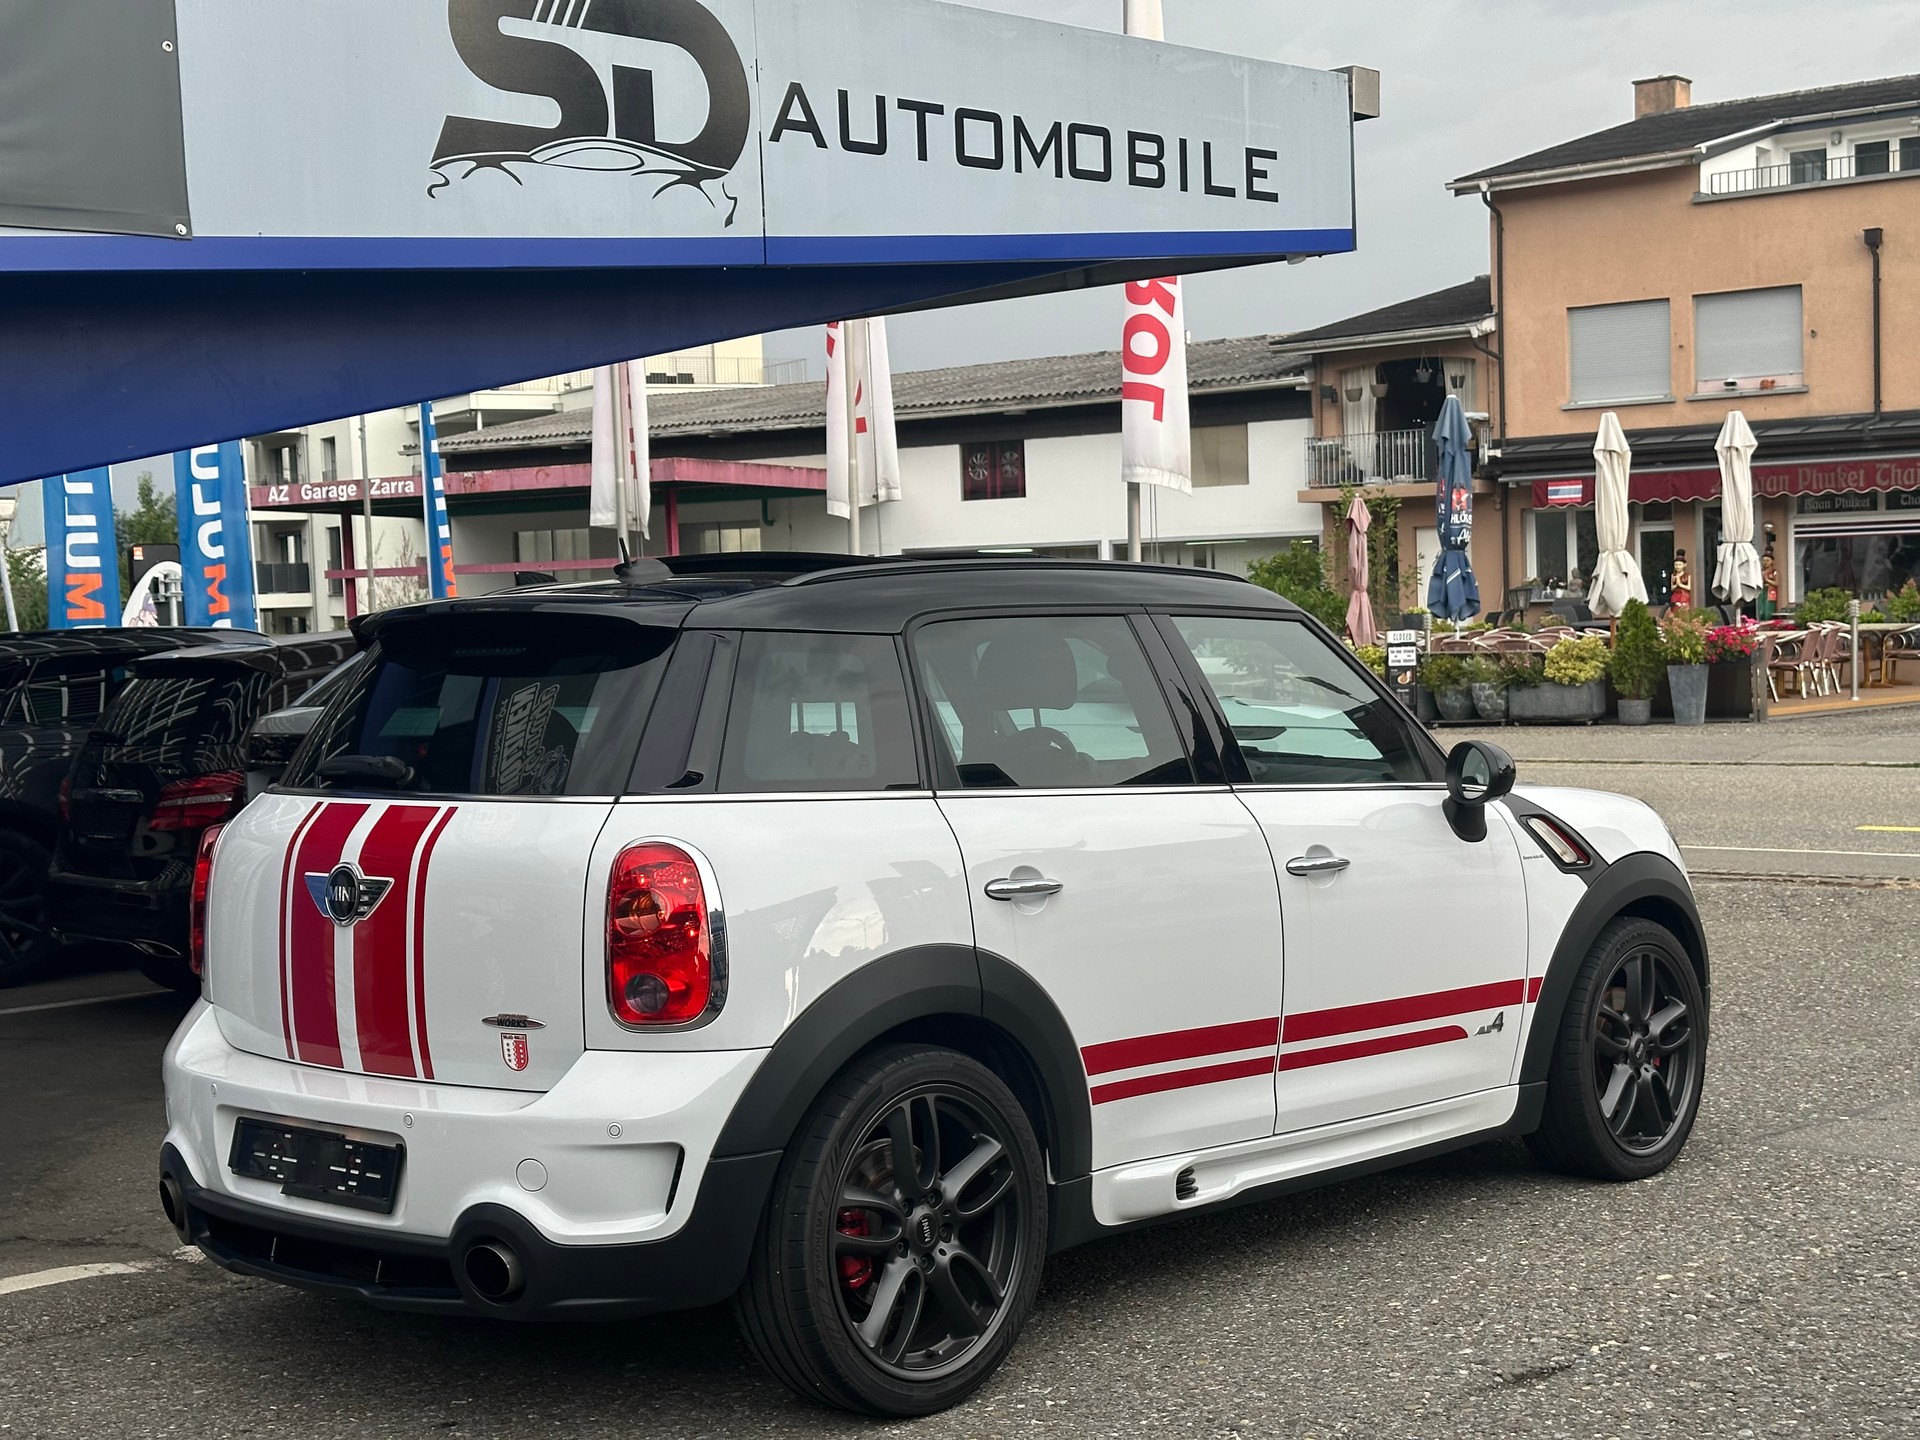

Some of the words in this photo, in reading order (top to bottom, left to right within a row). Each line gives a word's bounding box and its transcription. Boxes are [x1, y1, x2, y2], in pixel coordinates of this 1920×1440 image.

[768, 81, 1279, 202] AUTOMOBILE
[268, 485, 290, 502] AZ
[301, 483, 357, 501] Garage
[369, 478, 415, 495] Zarra
[1754, 471, 1789, 492] aan
[1798, 465, 1865, 490] Phuket
[1392, 633, 1412, 641] CLOSED
[329, 886, 355, 901] MINI
[497, 1018, 527, 1028] WORKS
[921, 1218, 931, 1242] MINI
